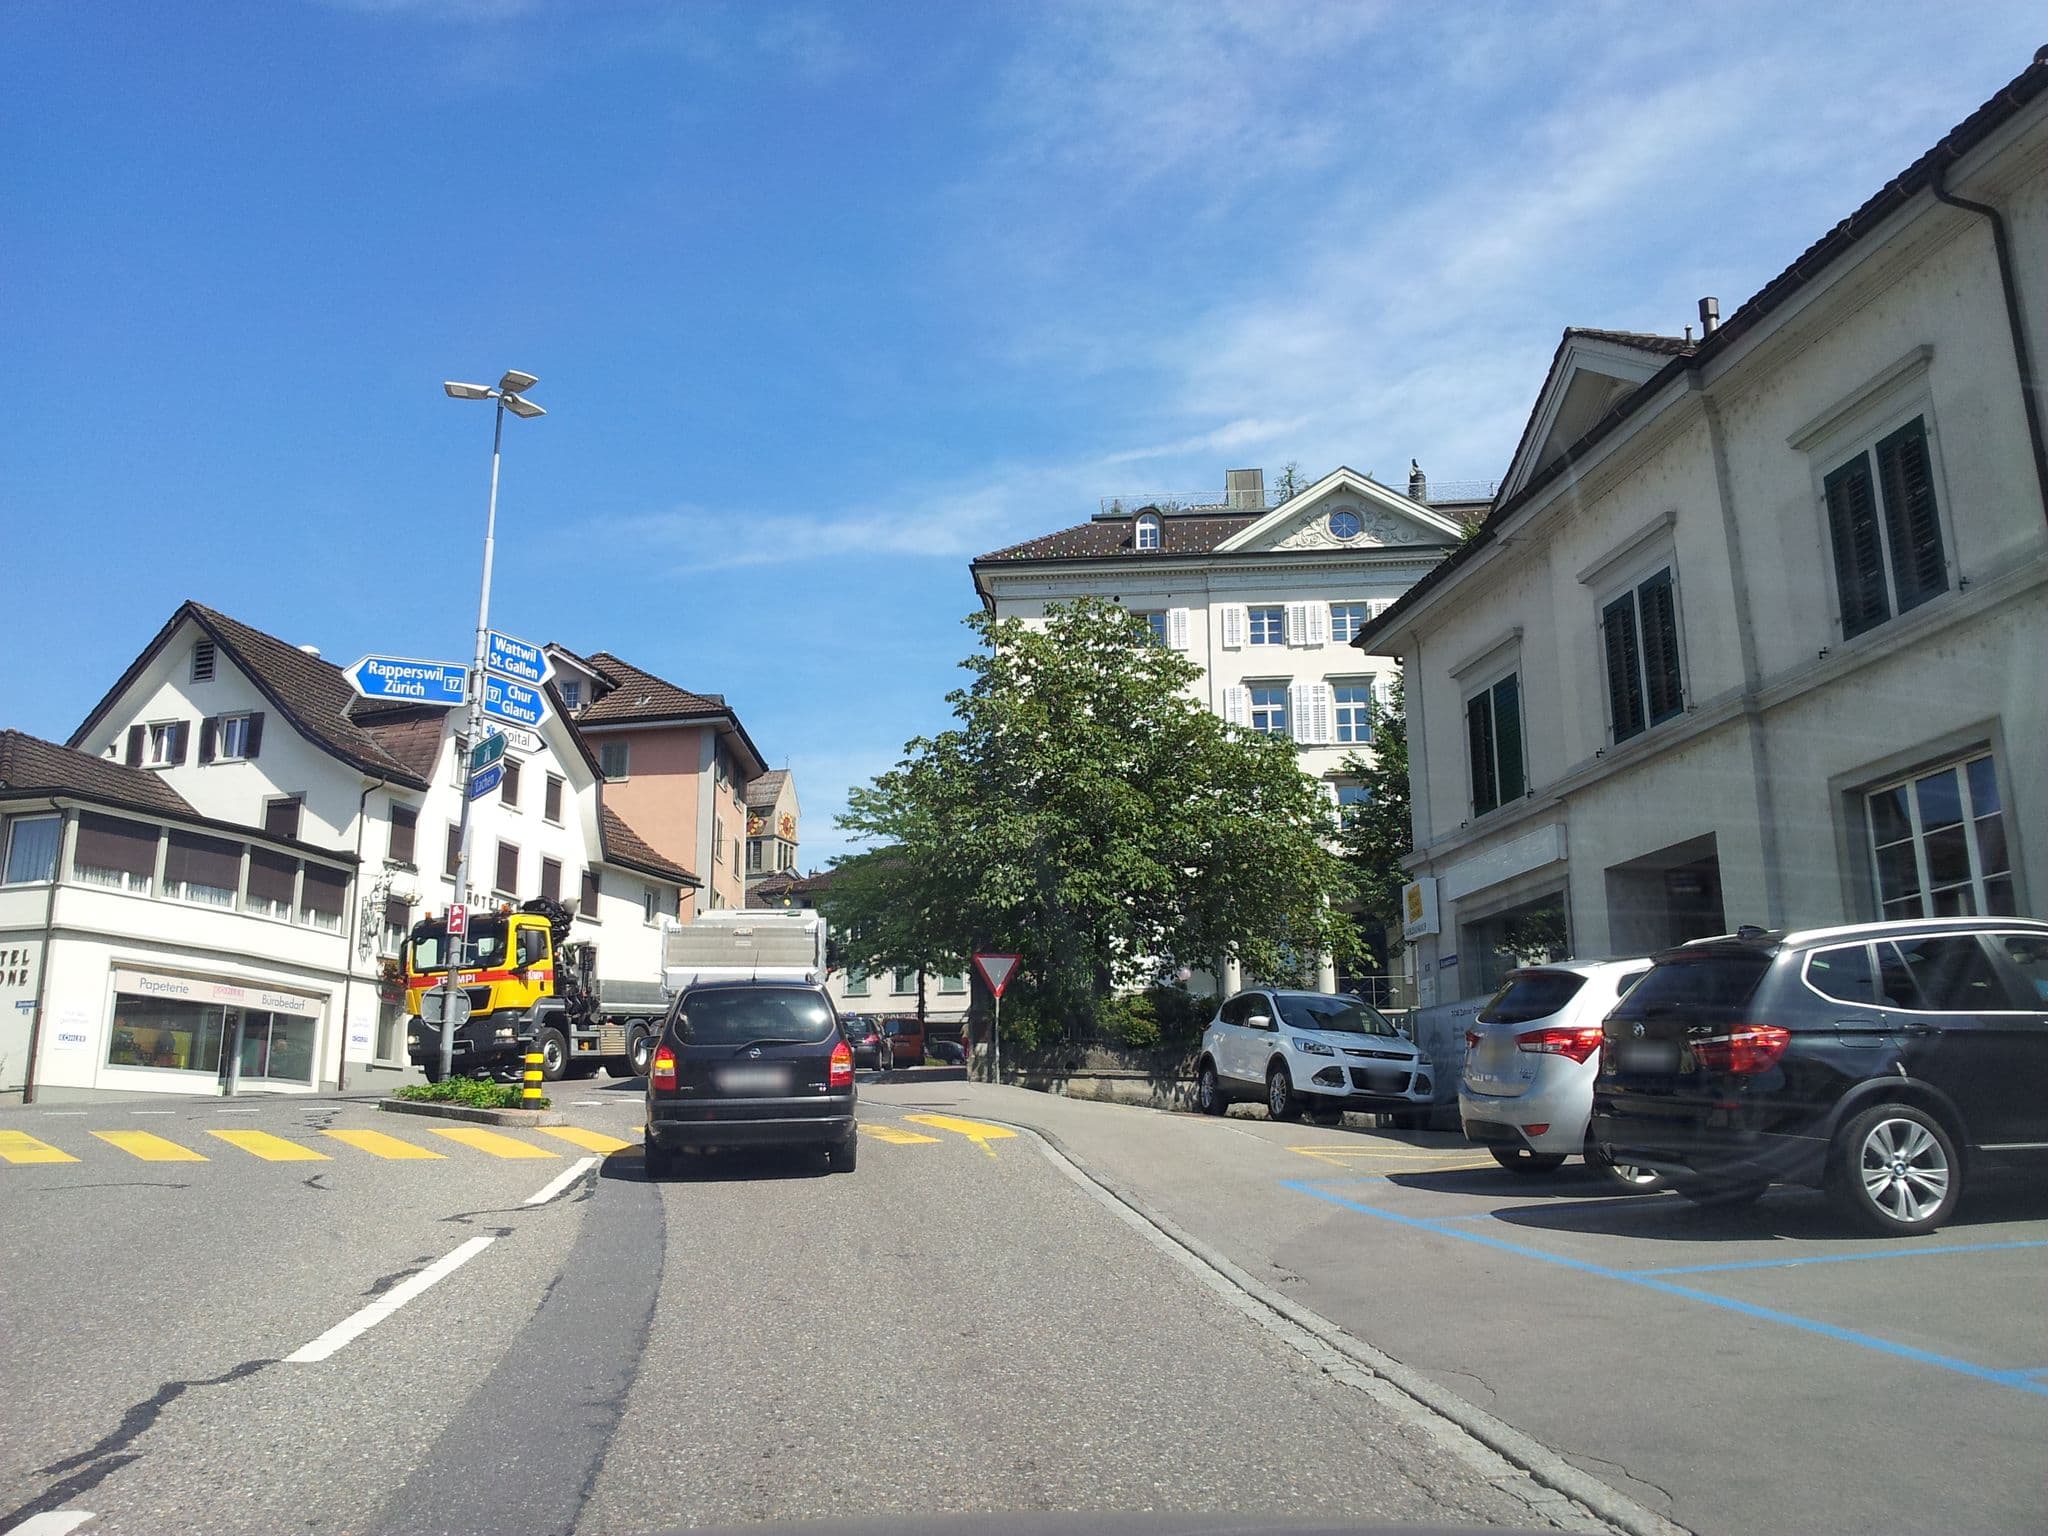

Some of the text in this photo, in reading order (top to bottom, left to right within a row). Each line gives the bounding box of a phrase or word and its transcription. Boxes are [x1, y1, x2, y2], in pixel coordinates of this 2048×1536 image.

[495, 636, 537, 662] Wattwil
[368, 660, 444, 681] Rapperswil
[490, 652, 539, 679] St. Gallen
[383, 679, 425, 696] Zürich
[447, 679, 461, 690] 17
[489, 689, 499, 700] 17
[508, 685, 532, 704] Chur
[502, 700, 536, 721] Glarus
[139, 977, 190, 994] Papeterie
[261, 994, 305, 1010] Bürobedarf
